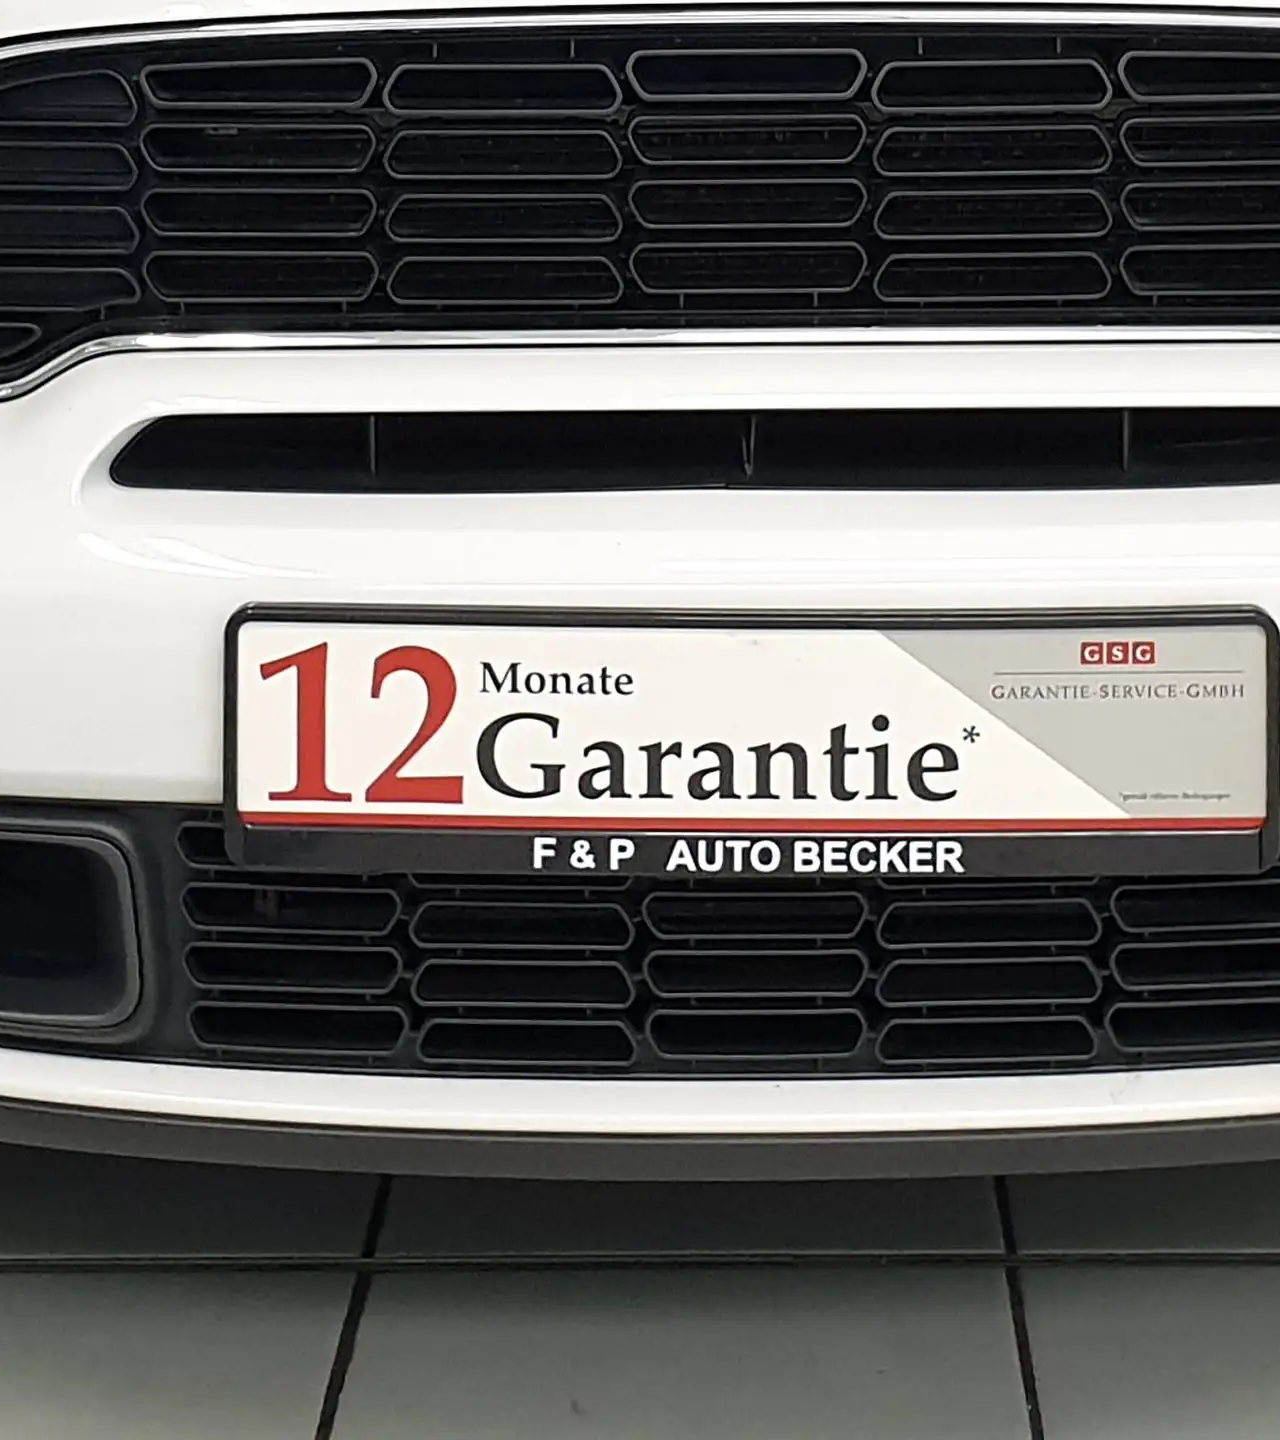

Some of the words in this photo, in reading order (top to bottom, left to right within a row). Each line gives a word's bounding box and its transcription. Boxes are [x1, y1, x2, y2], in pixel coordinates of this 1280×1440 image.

[1082, 643, 1153, 664] GSG
[479, 661, 634, 695] Monate
[260, 641, 464, 804] 12
[533, 837, 557, 869] F
[569, 840, 596, 870] &
[609, 839, 636, 870] P
[666, 839, 782, 872] AUTO
[793, 840, 965, 873] BECKER
